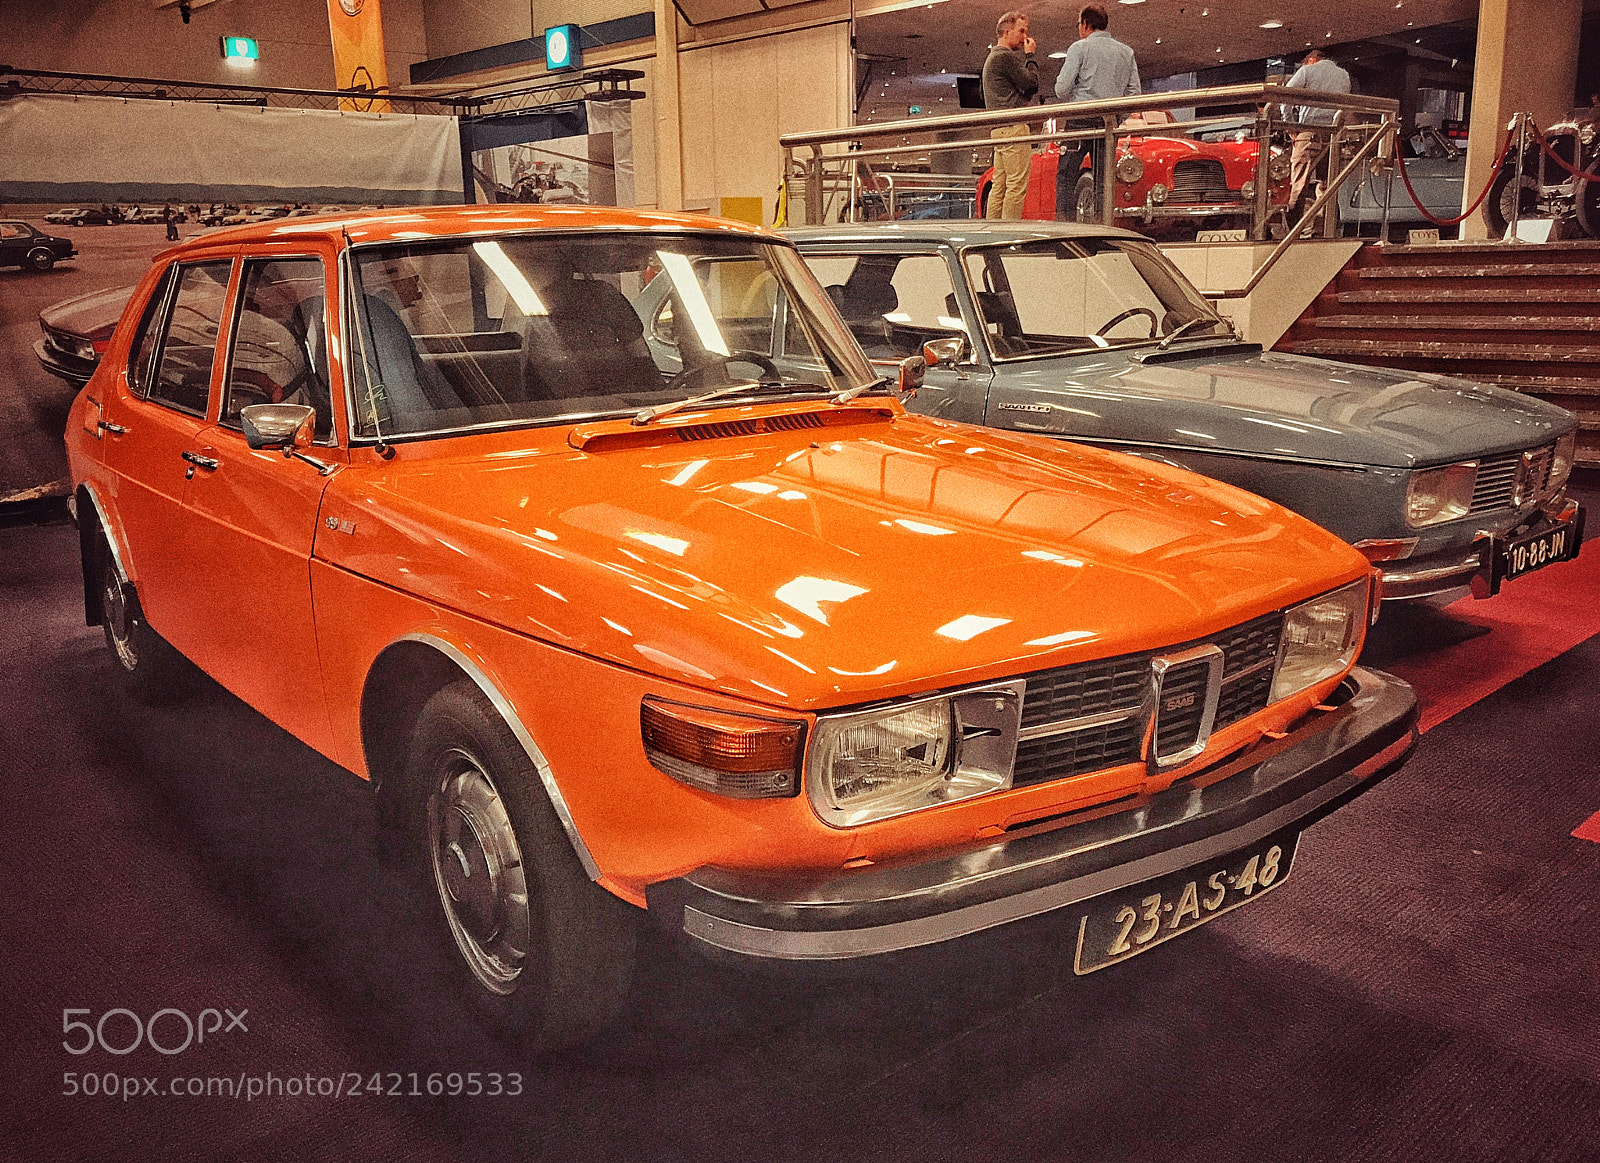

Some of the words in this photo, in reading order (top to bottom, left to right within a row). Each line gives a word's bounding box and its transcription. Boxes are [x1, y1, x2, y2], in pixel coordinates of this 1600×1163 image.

[1411, 231, 1438, 239] COYS
[1166, 695, 1195, 712] SAAB
[1106, 845, 1282, 956] 23-AS-48
